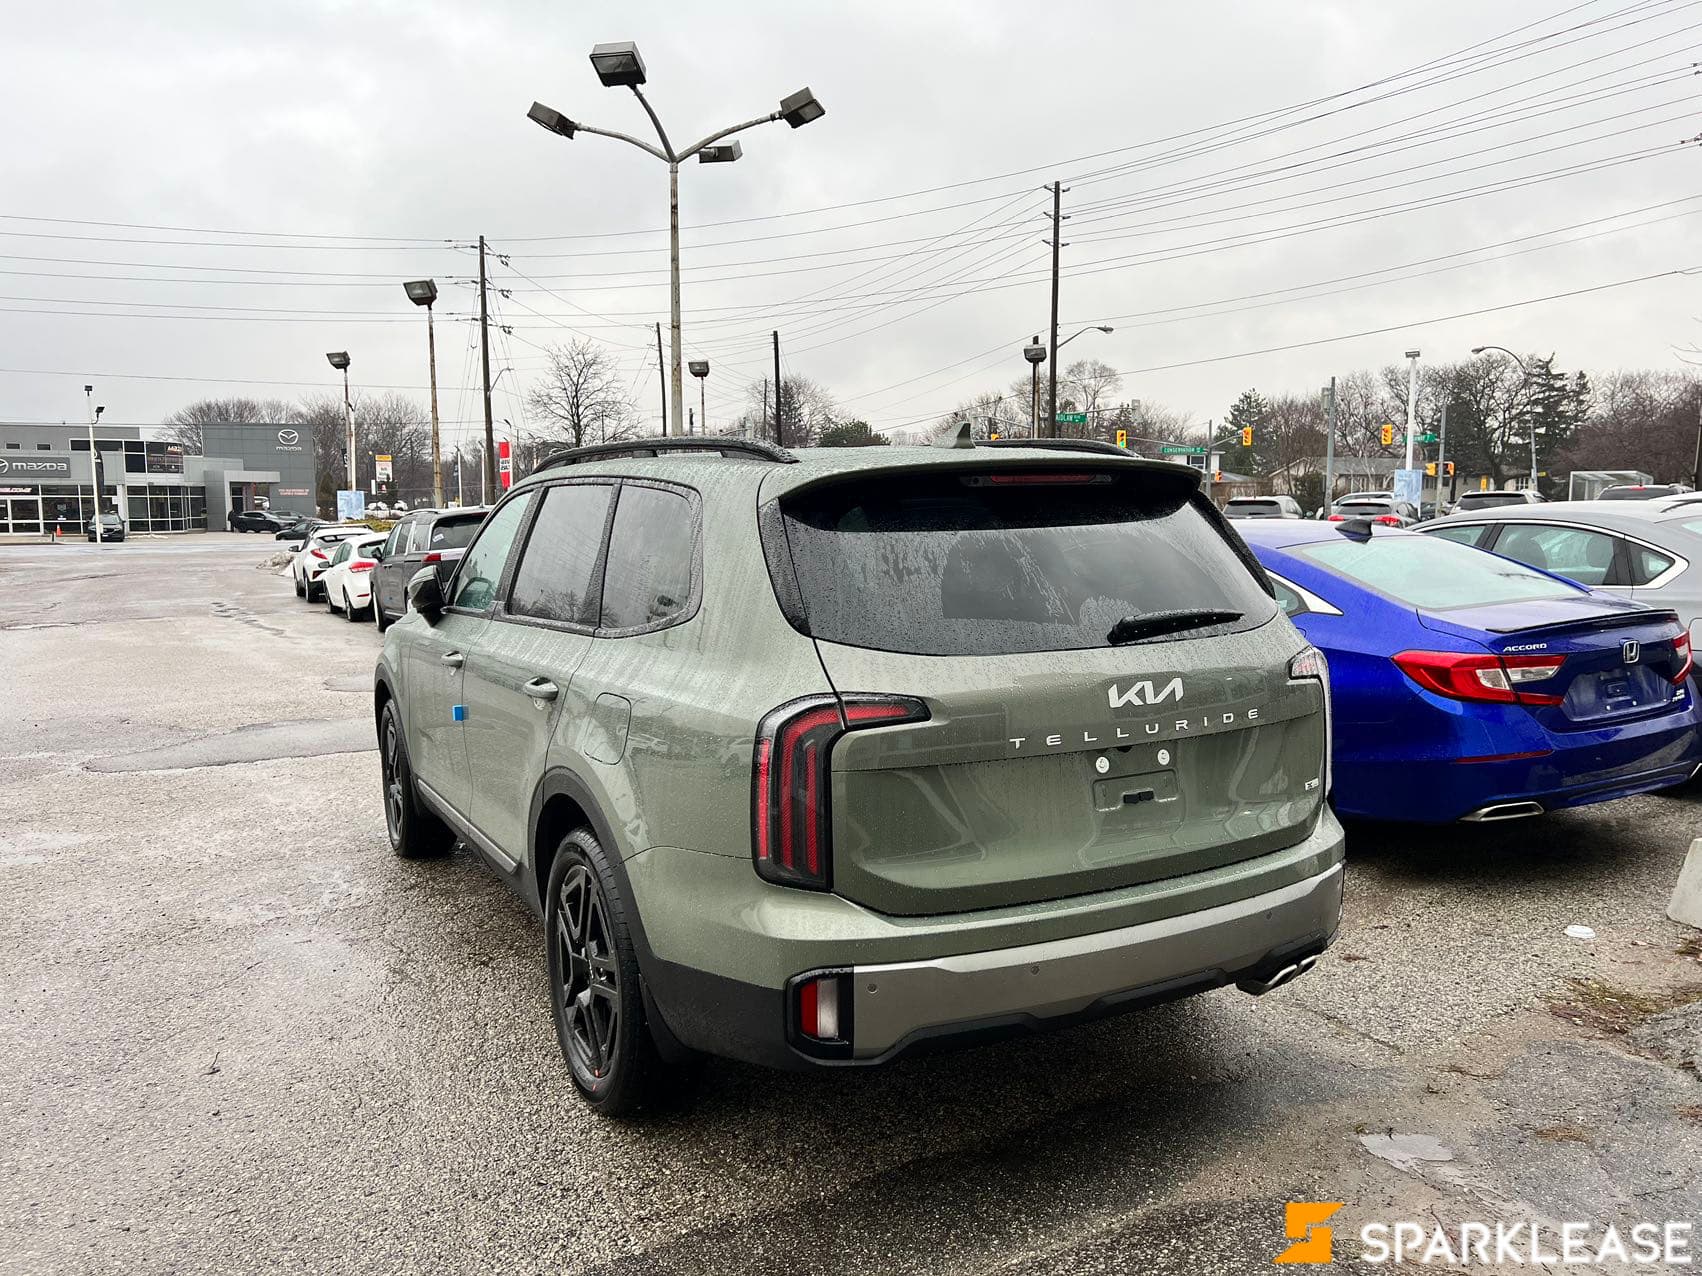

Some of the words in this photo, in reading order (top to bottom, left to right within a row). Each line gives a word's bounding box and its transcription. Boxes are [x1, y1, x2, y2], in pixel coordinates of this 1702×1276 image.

[12, 462, 68, 471] mazda
[1503, 642, 1547, 653] ACCORD
[1107, 677, 1184, 709] KIA
[1010, 708, 1259, 750] TELLURIDE
